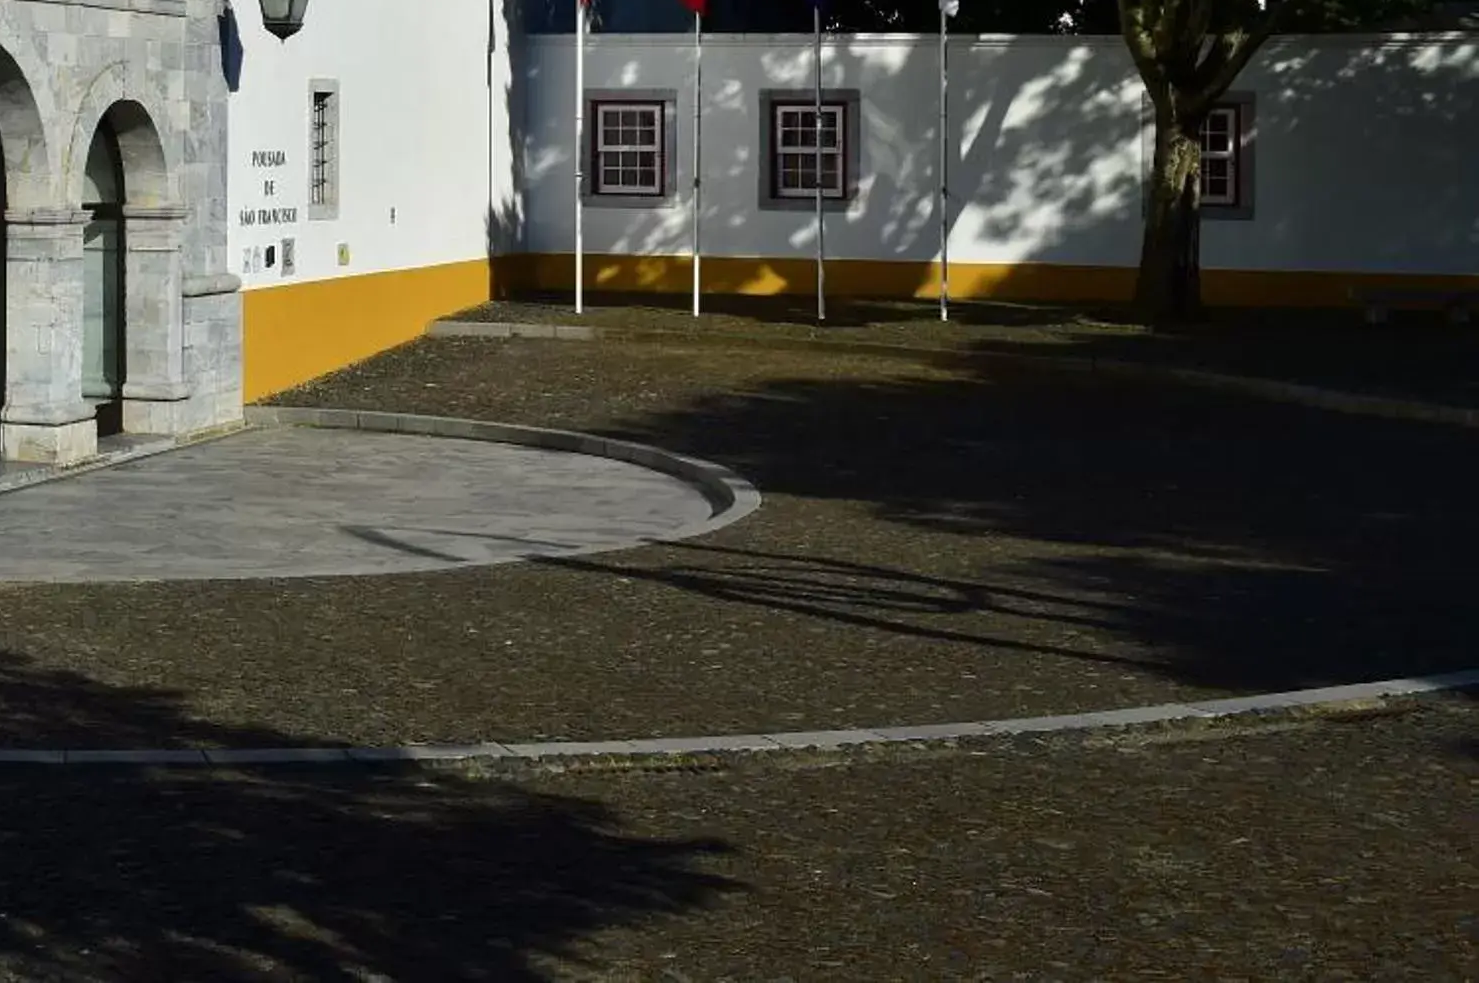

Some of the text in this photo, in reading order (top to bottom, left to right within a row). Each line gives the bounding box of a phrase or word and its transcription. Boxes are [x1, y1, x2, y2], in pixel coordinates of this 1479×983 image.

[252, 150, 286, 167] POUSADA
[264, 180, 275, 196] DE
[239, 206, 297, 226] SÃO FRANCISCO
